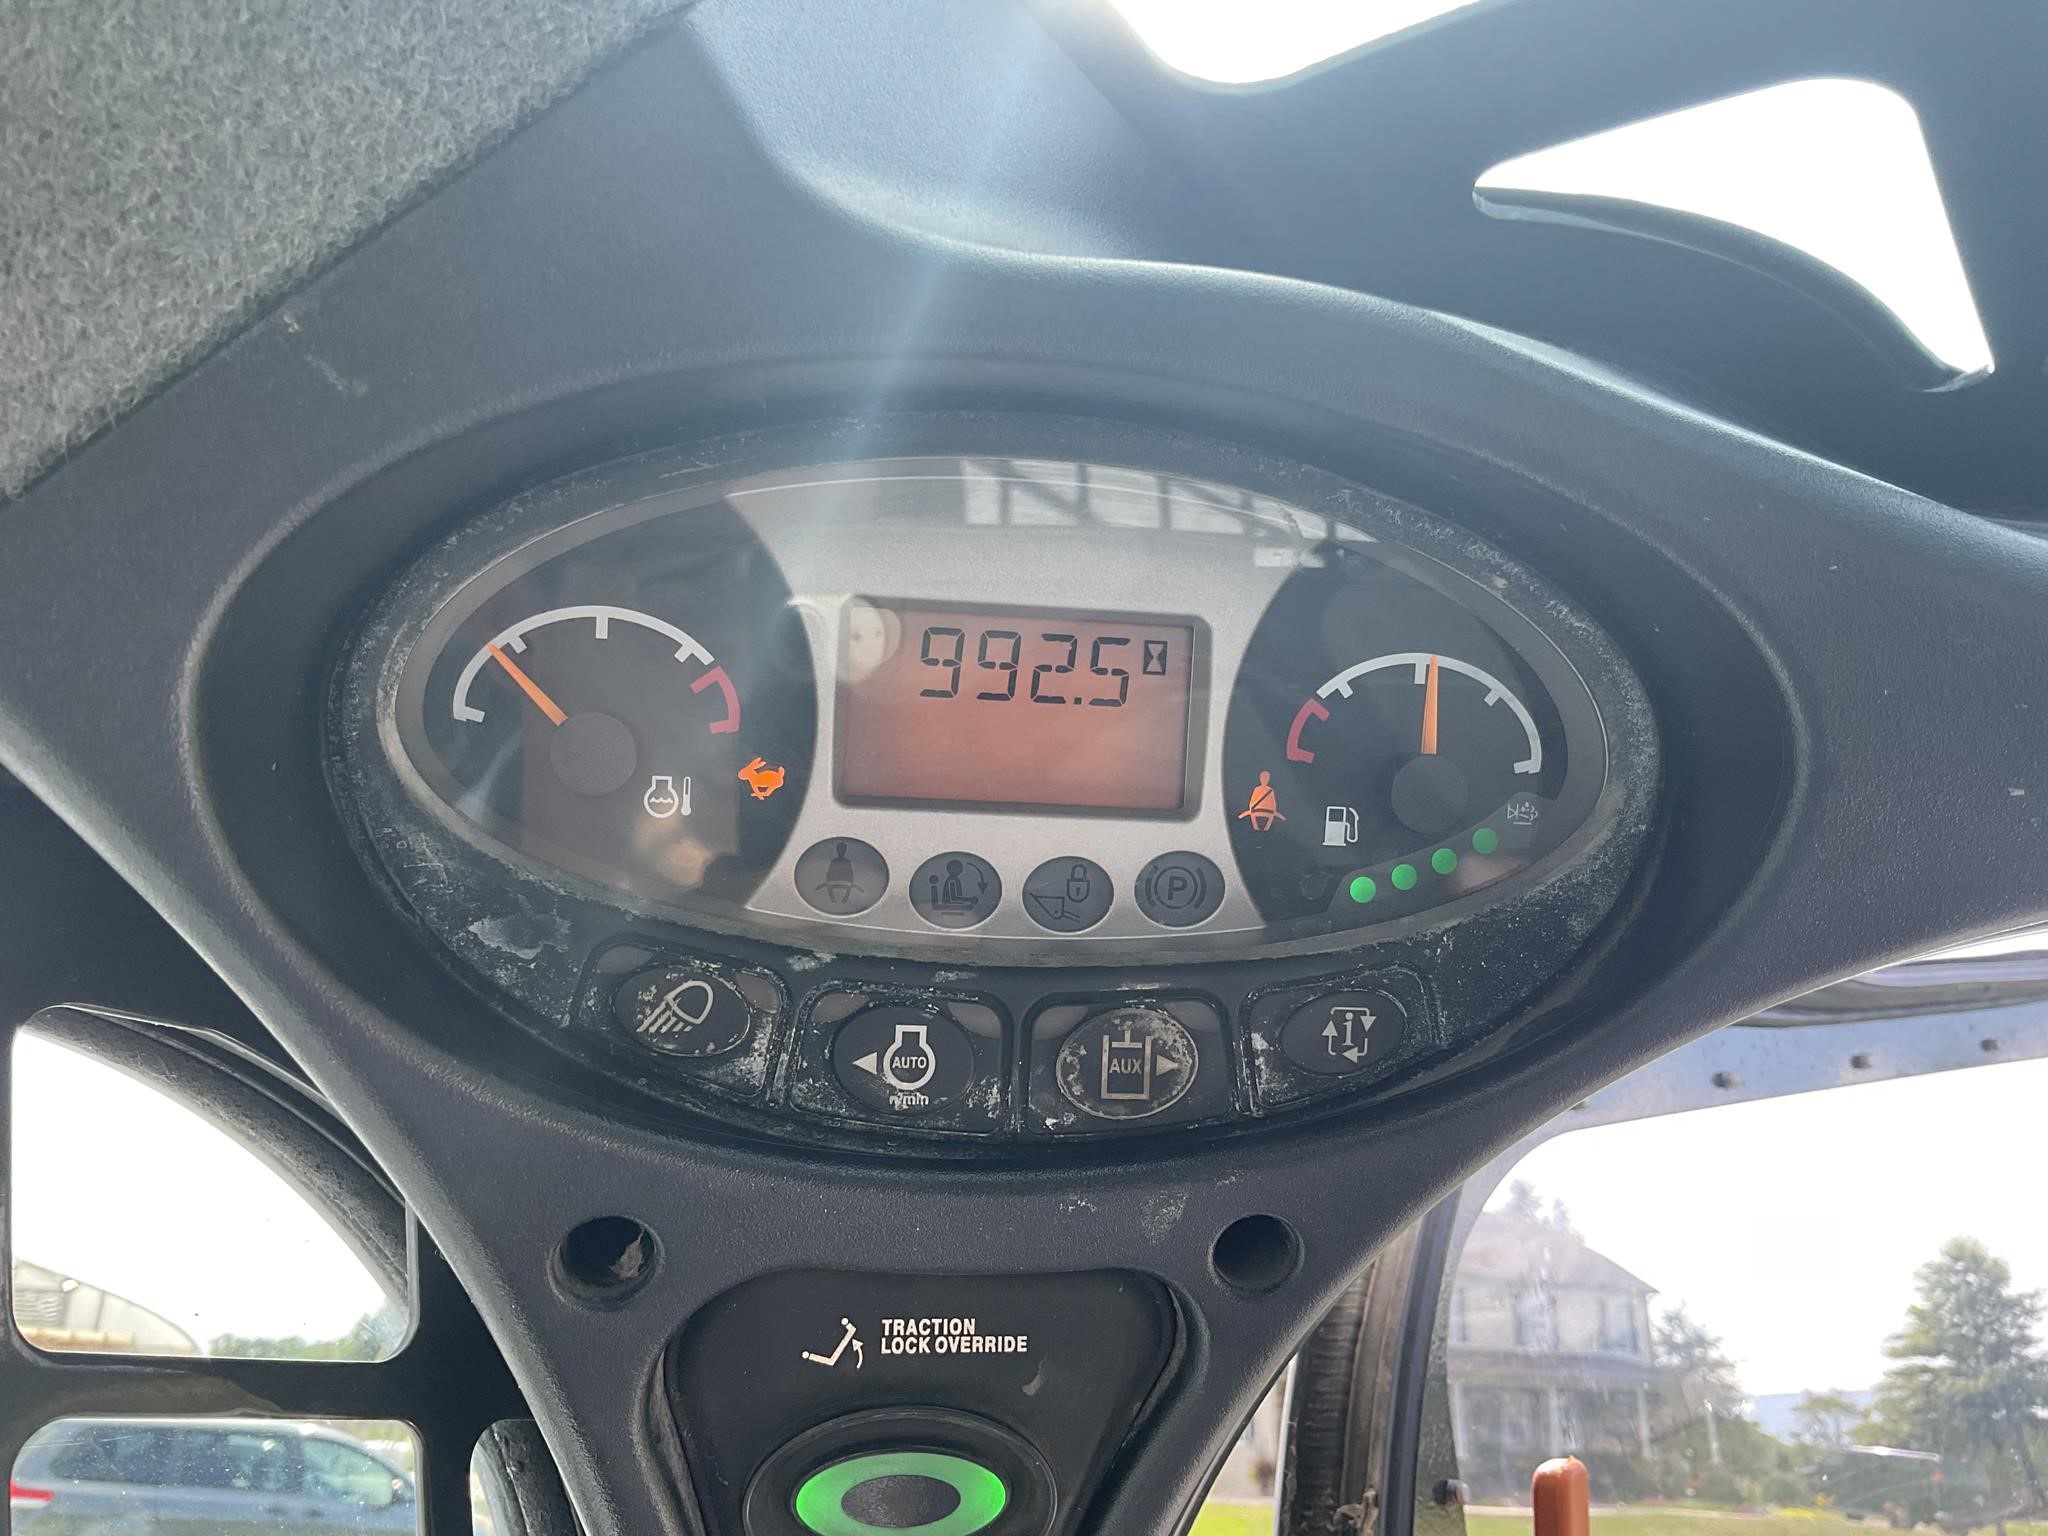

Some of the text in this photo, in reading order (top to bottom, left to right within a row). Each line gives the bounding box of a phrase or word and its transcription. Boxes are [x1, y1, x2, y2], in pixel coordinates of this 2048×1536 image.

[919, 627, 1131, 707] 992.5
[1167, 876, 1189, 901] P
[892, 1056, 927, 1069] AUTO
[1109, 1058, 1143, 1075] AUX
[881, 1318, 976, 1336] TRACTION
[880, 1336, 1028, 1354] LOCK OVERRIDE
